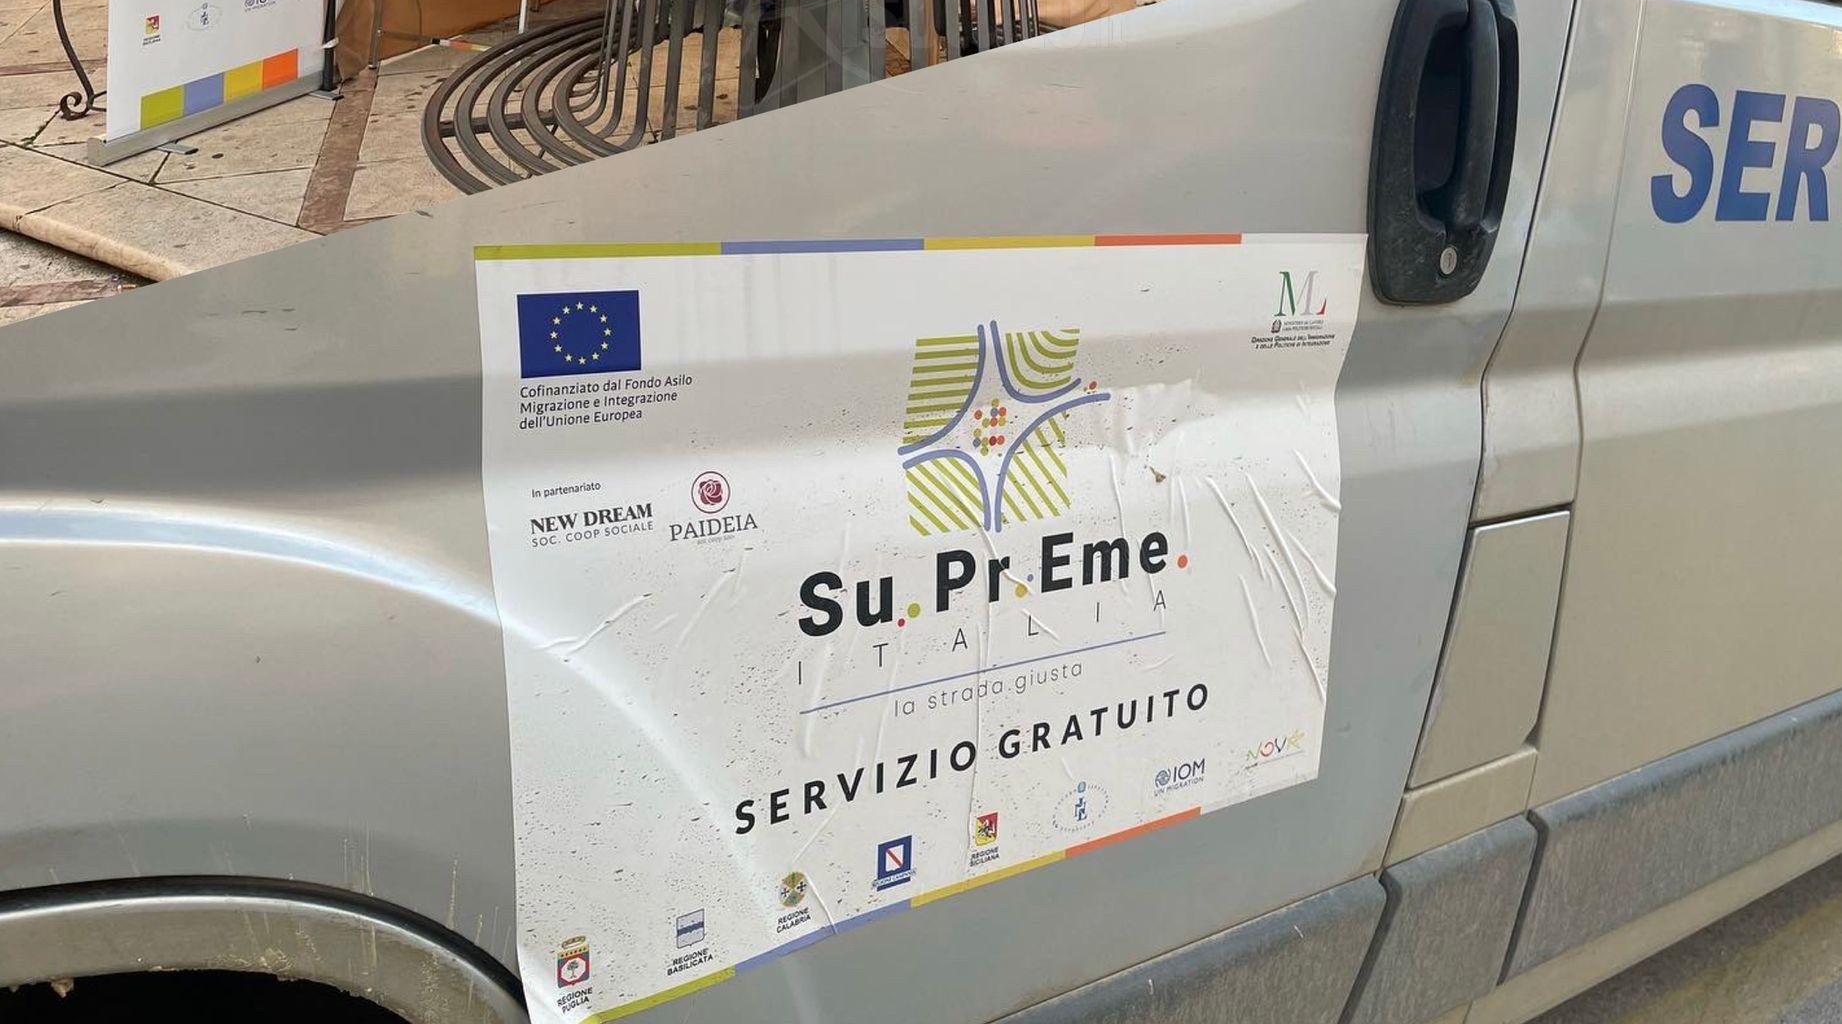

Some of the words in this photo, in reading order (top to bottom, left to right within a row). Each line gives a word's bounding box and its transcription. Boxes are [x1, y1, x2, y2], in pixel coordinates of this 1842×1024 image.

[1651, 83, 1841, 223] SER
[520, 382, 600, 398] Cofinanziato
[603, 379, 621, 392] dal
[625, 377, 661, 390] Fondo
[664, 374, 692, 387] Asilo
[520, 398, 590, 415] Migrazione
[593, 399, 600, 408] e
[604, 391, 678, 408] Integrazione
[519, 414, 590, 430] dell'Unione
[594, 410, 642, 425] Europea
[531, 488, 542, 498] In
[544, 482, 601, 499] partenariato
[530, 513, 583, 534] NEW
[583, 503, 653, 527] DREAM
[669, 513, 758, 542] PAIDEIA
[531, 535, 561, 548] SOC.
[565, 530, 600, 543] COOP
[604, 521, 653, 536] SOCIALE
[894, 699, 915, 717] la
[928, 678, 1003, 709] strada
[1015, 662, 1083, 695] giusta
[735, 740, 976, 834] SERVIZIO
[999, 683, 1208, 759] GRATUITO
[1172, 758, 1205, 783] IOM
[1167, 776, 1204, 792] MIGRATION
[777, 914, 811, 933] CALABRIA
[778, 907, 809, 924] REGIONE
[667, 954, 713, 976] BASILICATA
[672, 947, 709, 965] REGIONE
[557, 986, 593, 1007] REGIONE
[562, 996, 590, 1014] PUGLIA
